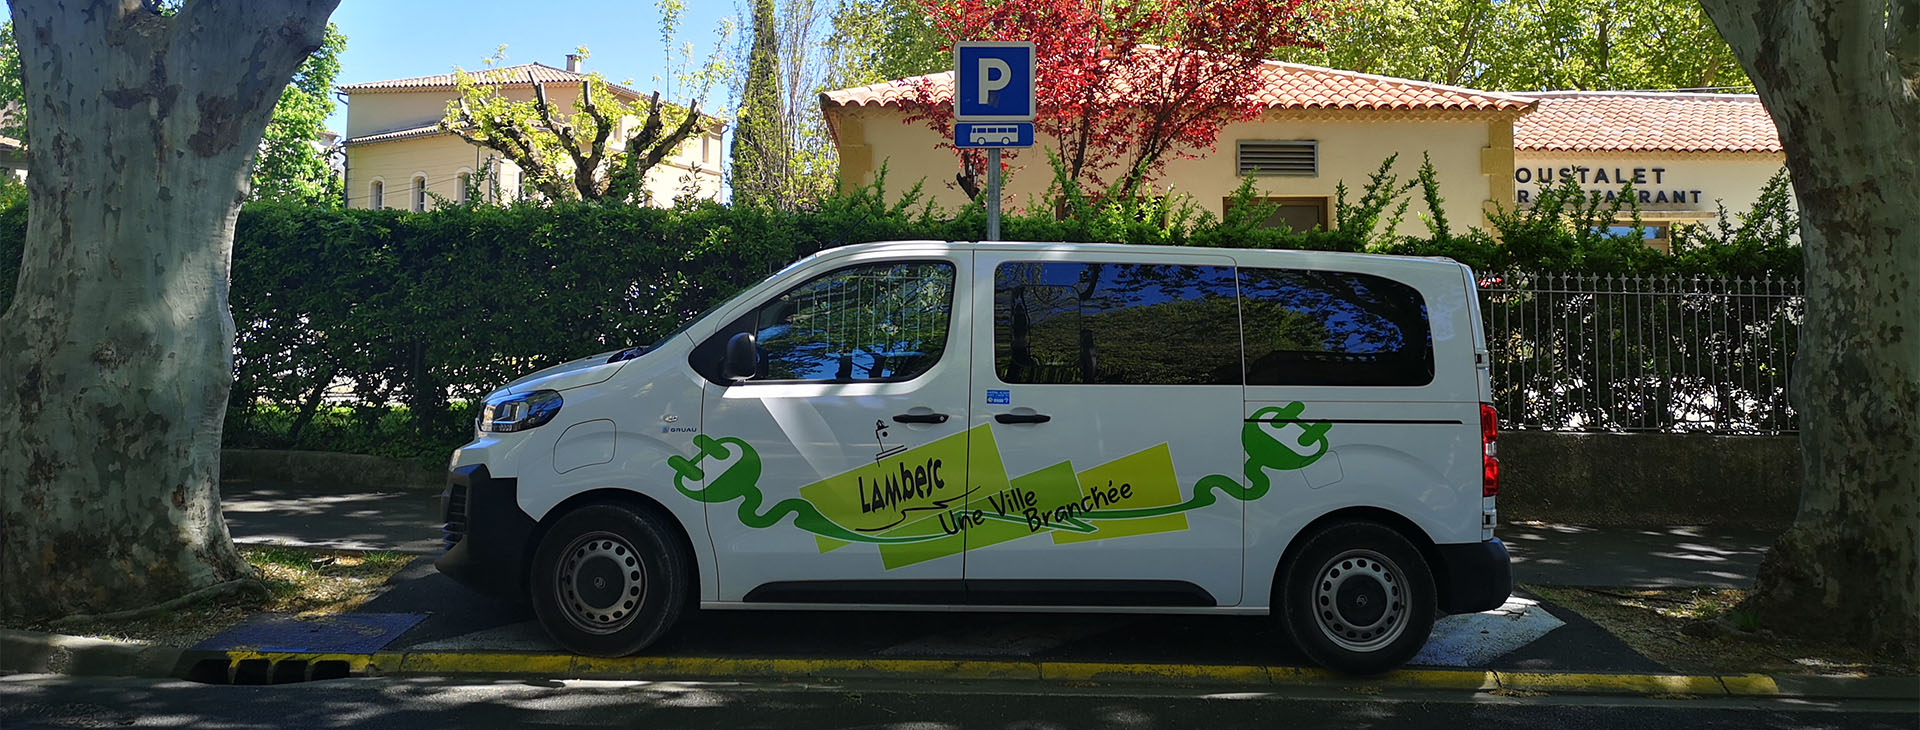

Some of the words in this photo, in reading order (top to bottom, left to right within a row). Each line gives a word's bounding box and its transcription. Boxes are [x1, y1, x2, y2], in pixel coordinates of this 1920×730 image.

[978, 58, 1012, 105] P
[1515, 167, 1666, 184] OUSTALET
[938, 509, 986, 535] Une
[987, 488, 1038, 517] Ville
[1022, 480, 1133, 533] Branchée
